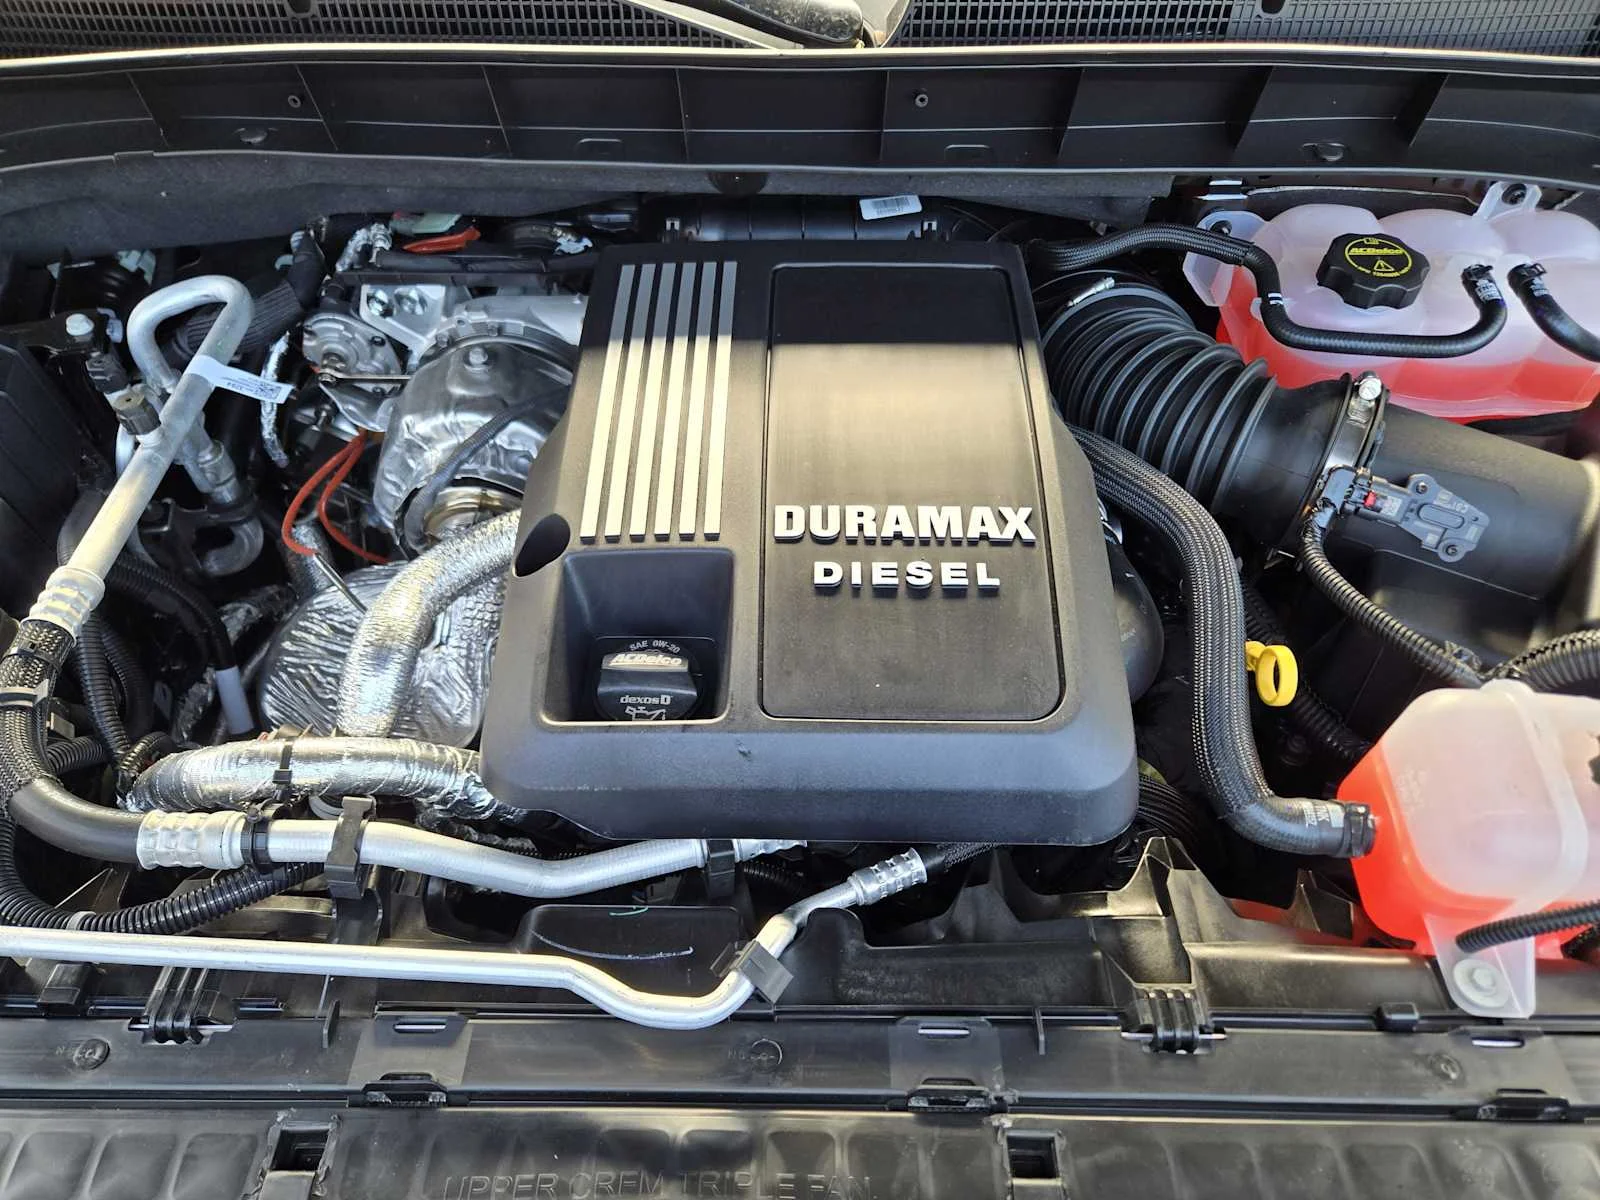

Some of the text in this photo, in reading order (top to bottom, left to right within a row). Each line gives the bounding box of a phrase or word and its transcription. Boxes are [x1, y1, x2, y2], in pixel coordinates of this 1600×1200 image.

[774, 504, 1037, 543] DURAMAX
[813, 560, 1001, 590] DIESEL
[608, 653, 682, 666] ACDelco
[629, 639, 681, 654] SAE 0W-20
[444, 1173, 560, 1200] UPPER
[680, 1171, 796, 1199] TRIPLE
